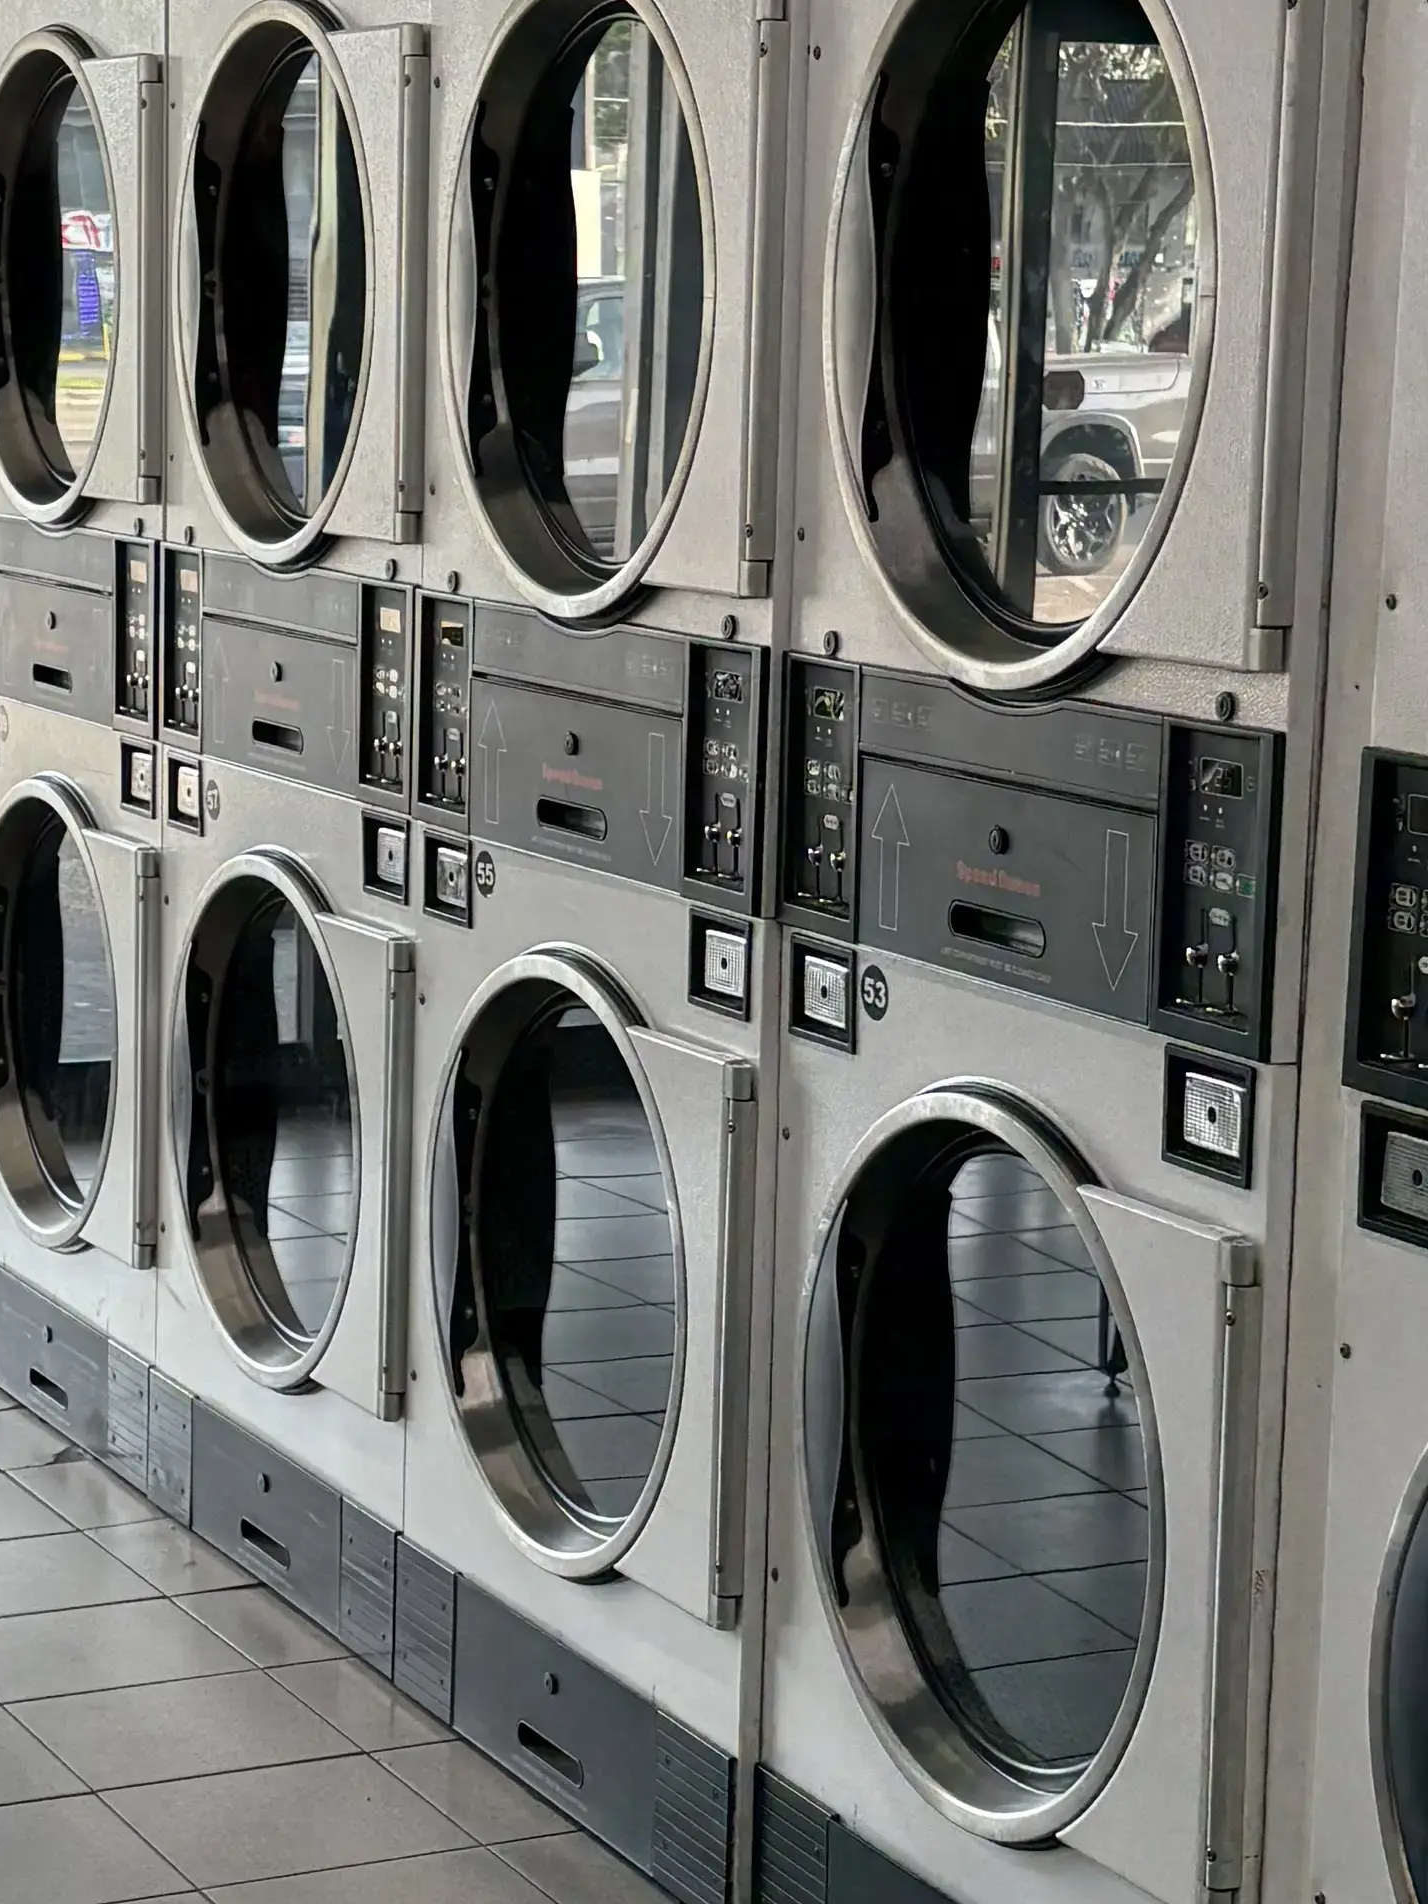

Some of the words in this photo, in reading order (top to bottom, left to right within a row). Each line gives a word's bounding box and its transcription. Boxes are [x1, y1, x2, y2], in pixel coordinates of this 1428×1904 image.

[207, 788, 218, 810] 57
[477, 861, 494, 886] 55
[863, 976, 886, 1009] 53
